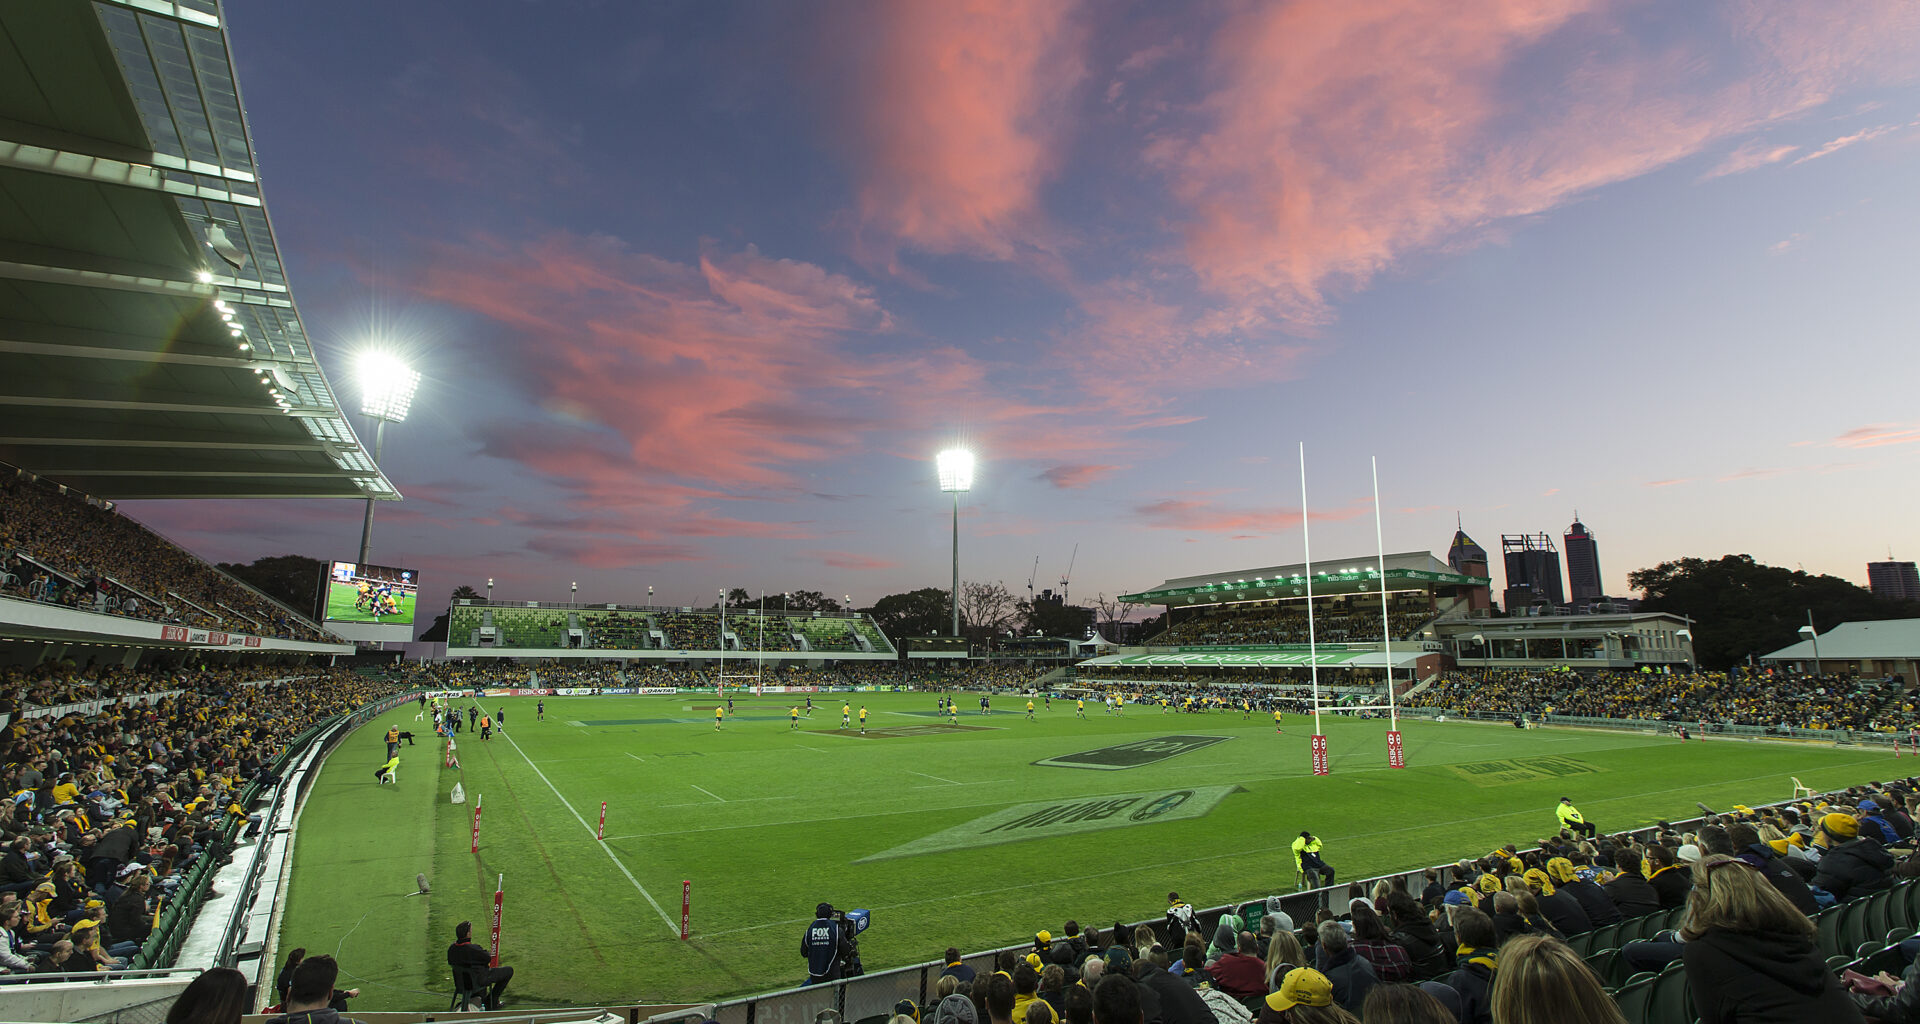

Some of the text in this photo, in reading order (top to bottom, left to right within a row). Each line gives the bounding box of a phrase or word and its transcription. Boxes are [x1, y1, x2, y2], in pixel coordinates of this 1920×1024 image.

[1389, 745, 1397, 766] HSBC
[978, 796, 1144, 834] BMW
[812, 928, 829, 937] FOX
